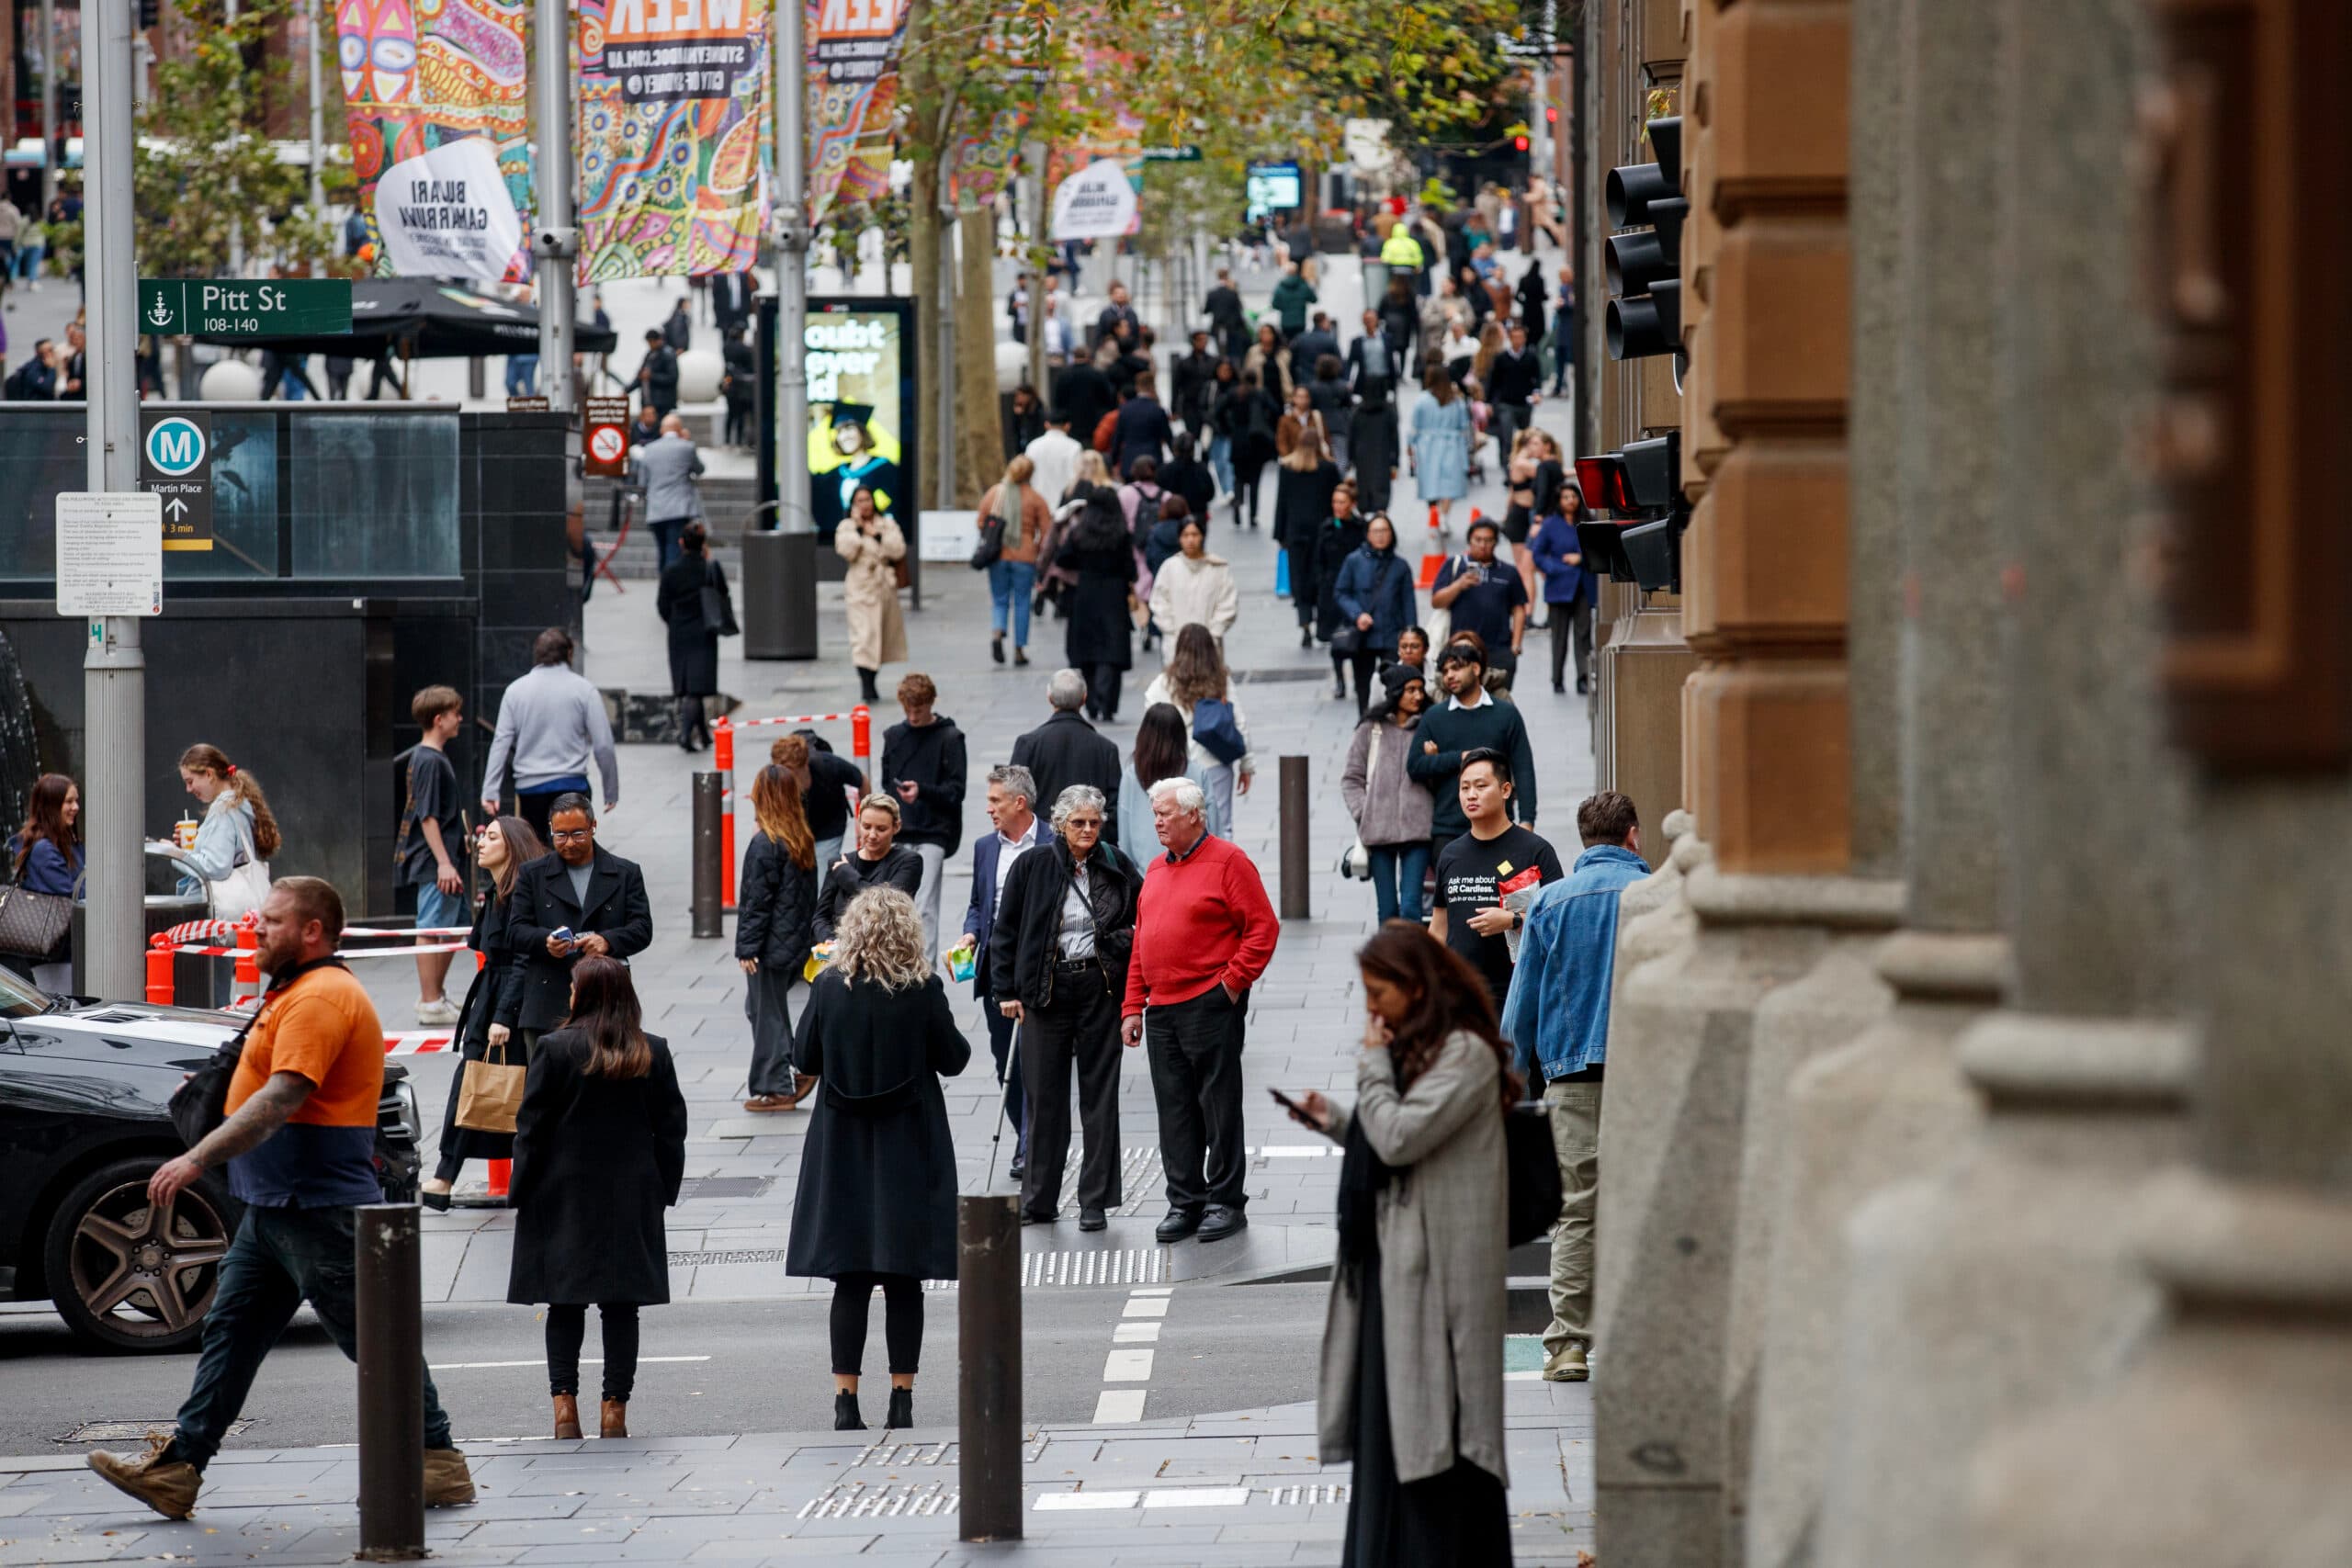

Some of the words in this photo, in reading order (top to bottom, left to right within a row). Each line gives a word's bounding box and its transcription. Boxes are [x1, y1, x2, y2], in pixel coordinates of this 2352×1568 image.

[202, 285, 250, 311] Pitt
[257, 285, 287, 311] St
[204, 317, 258, 333] 108-140
[805, 318, 886, 349] oubt
[160, 431, 191, 463] M
[151, 483, 178, 493] Martin
[180, 483, 202, 493] Place
[170, 524, 175, 533] 3
[177, 524, 194, 533] min
[1448, 875, 1461, 885] Ask
[1475, 875, 1496, 884] about
[1447, 885, 1458, 894] QR
[1459, 884, 1494, 893] Cardless.
